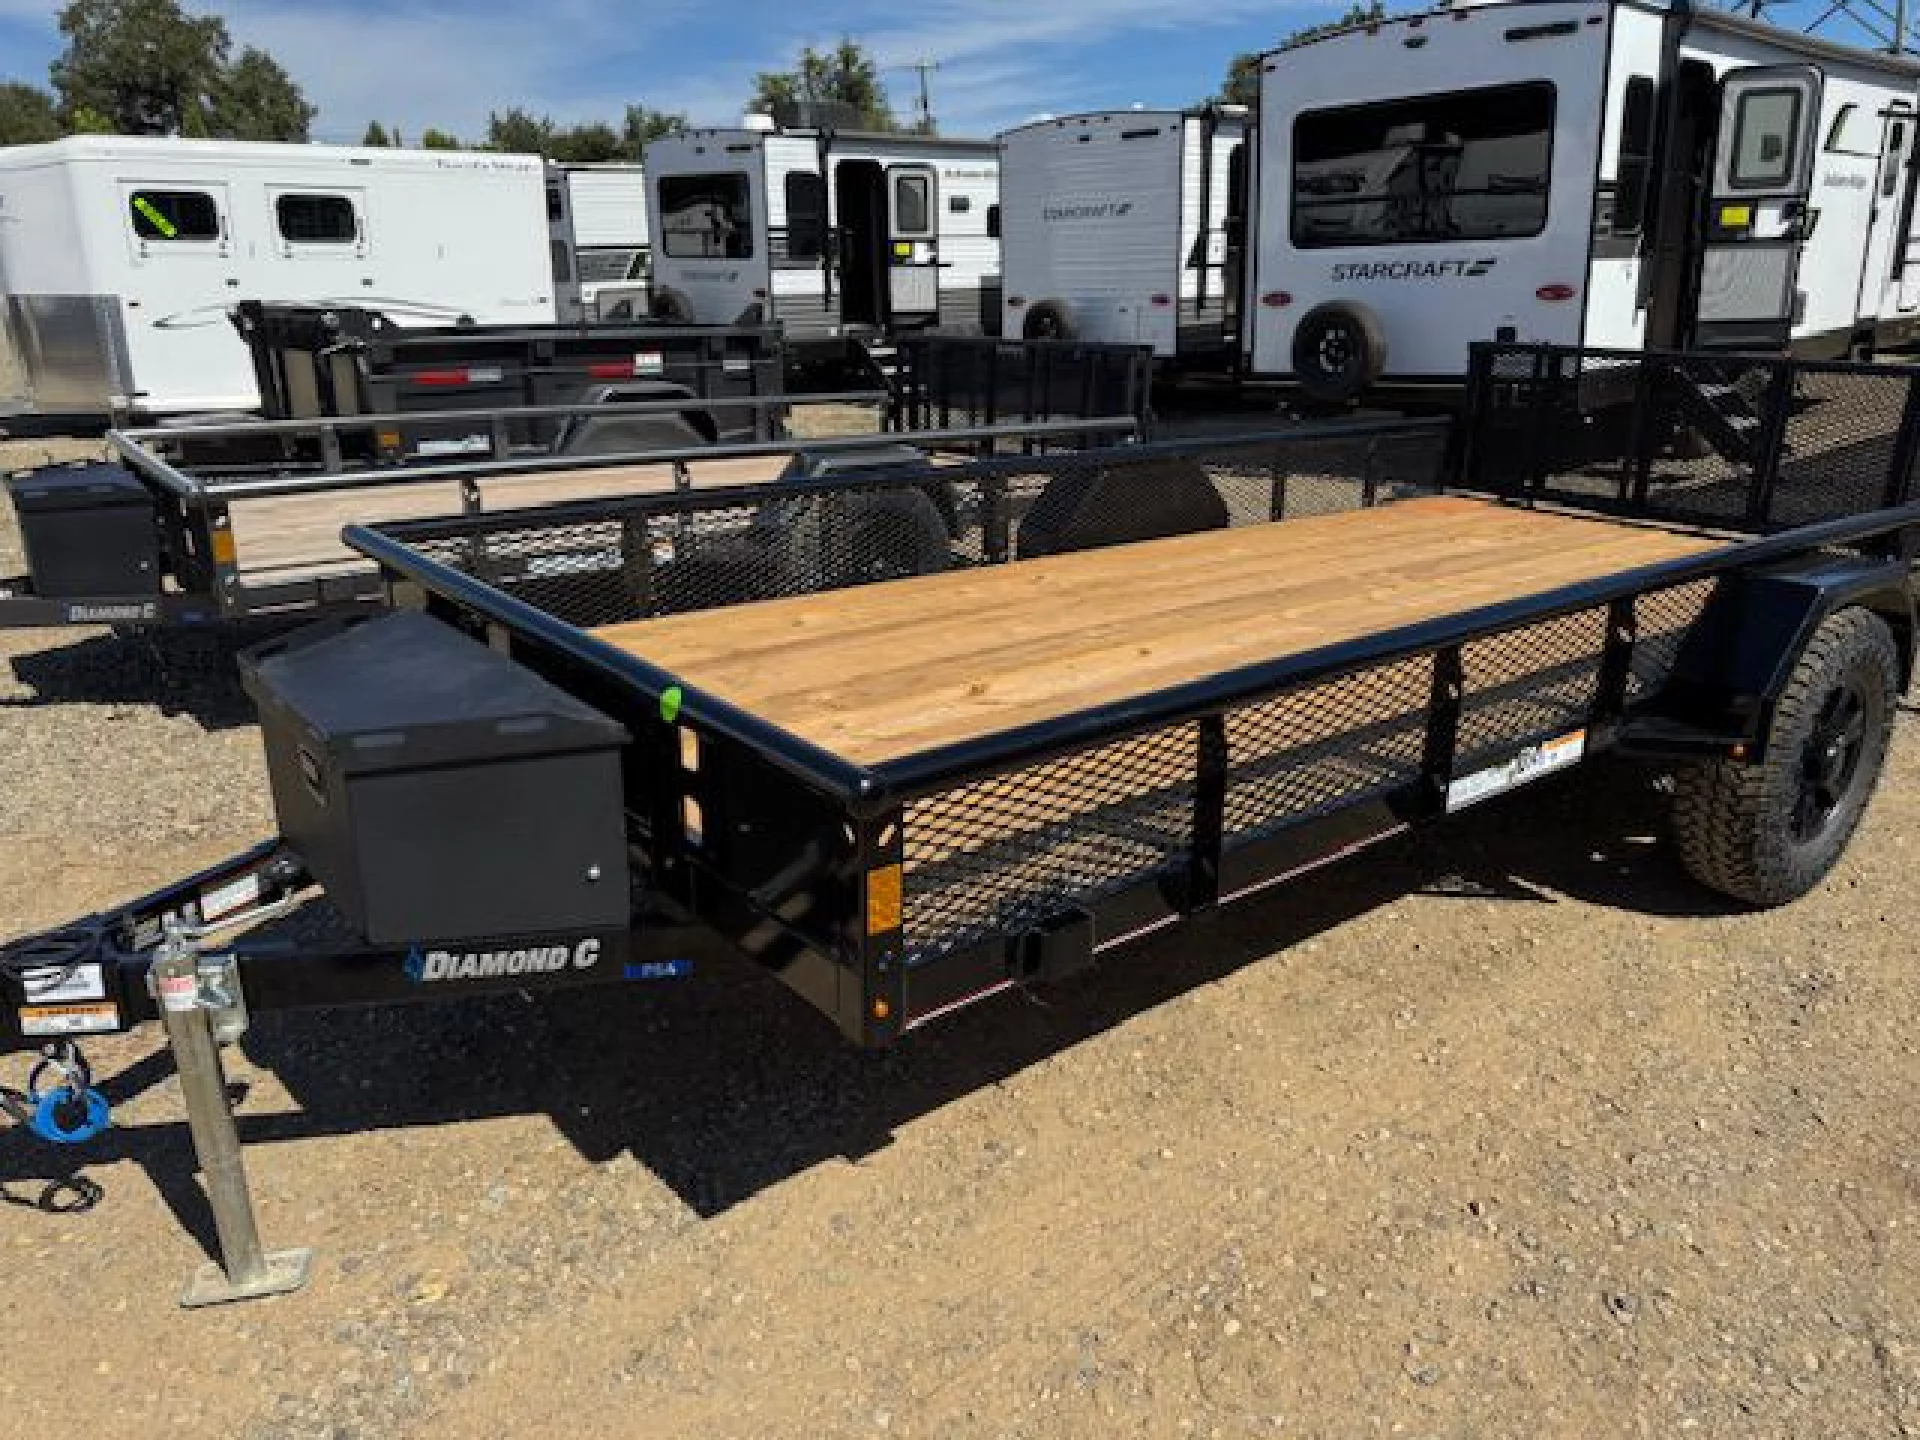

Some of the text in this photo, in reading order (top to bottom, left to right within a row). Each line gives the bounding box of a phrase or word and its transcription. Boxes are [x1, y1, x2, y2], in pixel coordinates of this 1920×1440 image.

[1331, 260, 1471, 283] STARCRAFT
[422, 938, 600, 981] DIAMOND C
